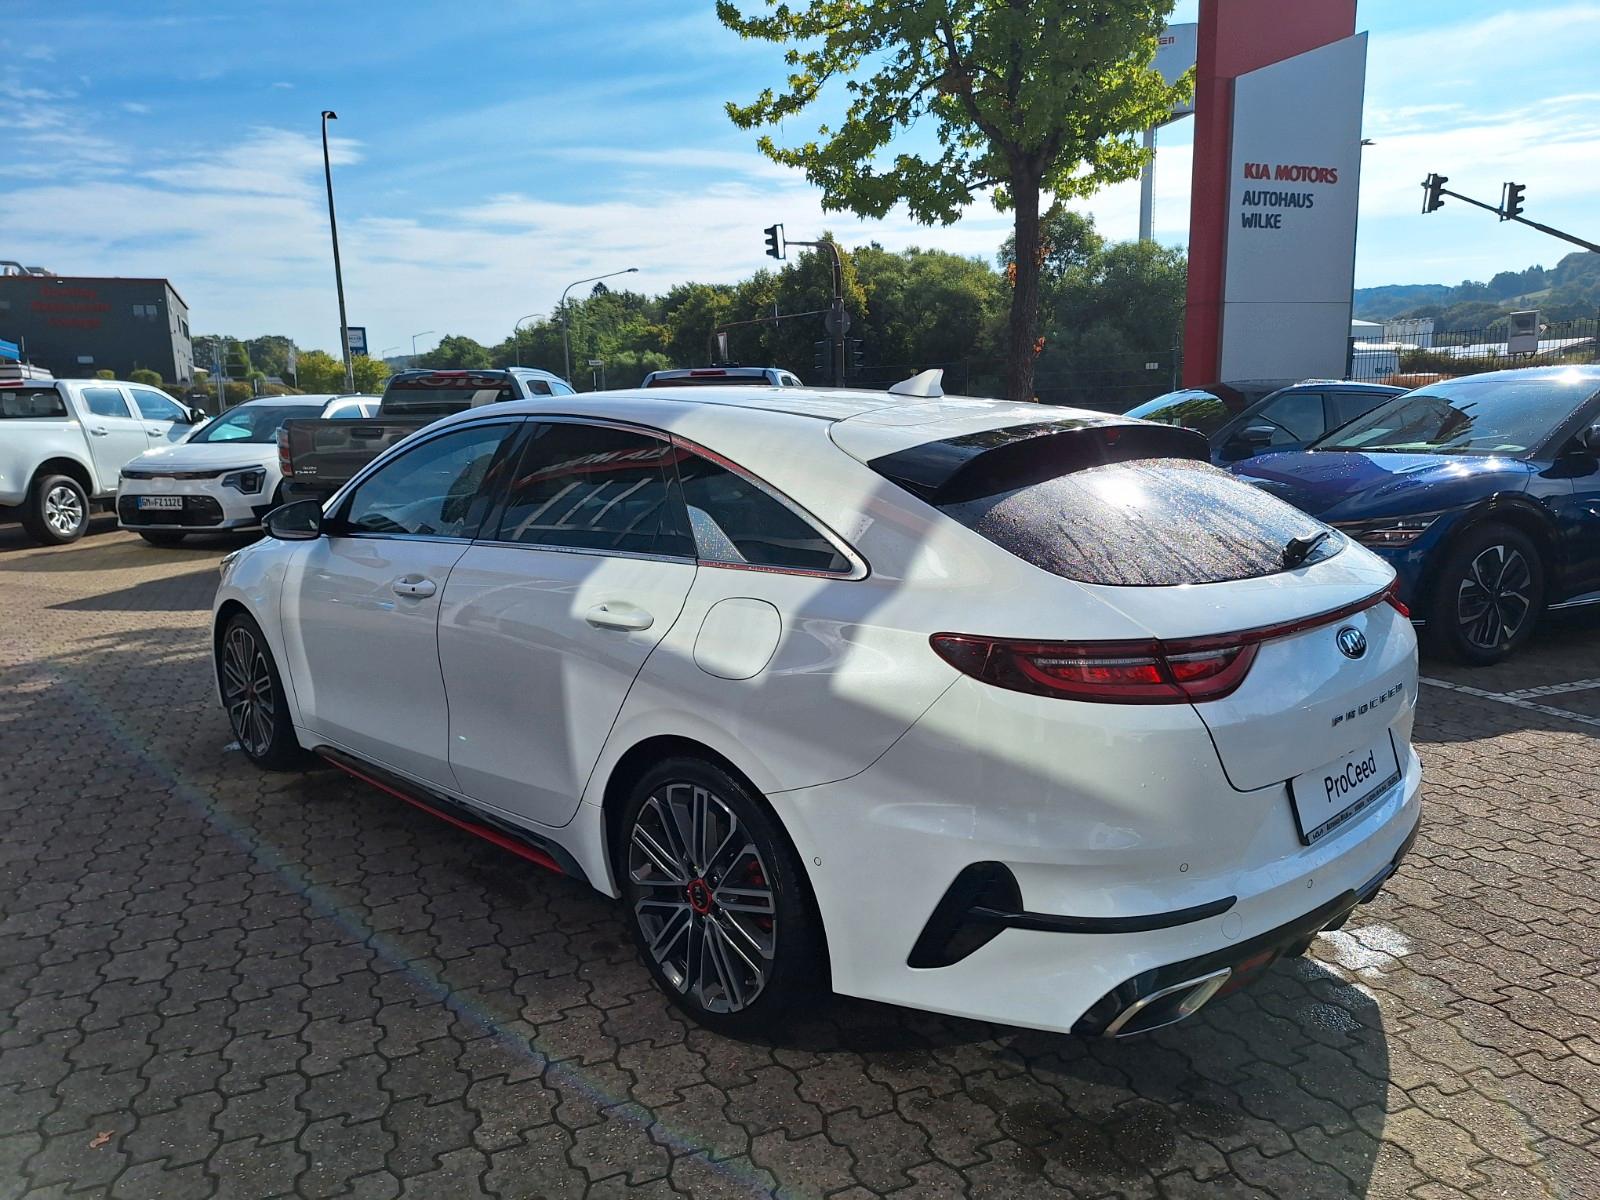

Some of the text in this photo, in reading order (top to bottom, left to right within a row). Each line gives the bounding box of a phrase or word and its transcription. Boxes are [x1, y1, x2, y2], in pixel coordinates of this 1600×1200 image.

[1243, 162, 1338, 184] KIA MOTORS
[1242, 190, 1314, 208] AUTOHAUS
[1241, 212, 1282, 229] WILKE
[1324, 749, 1377, 803] ProCeed
